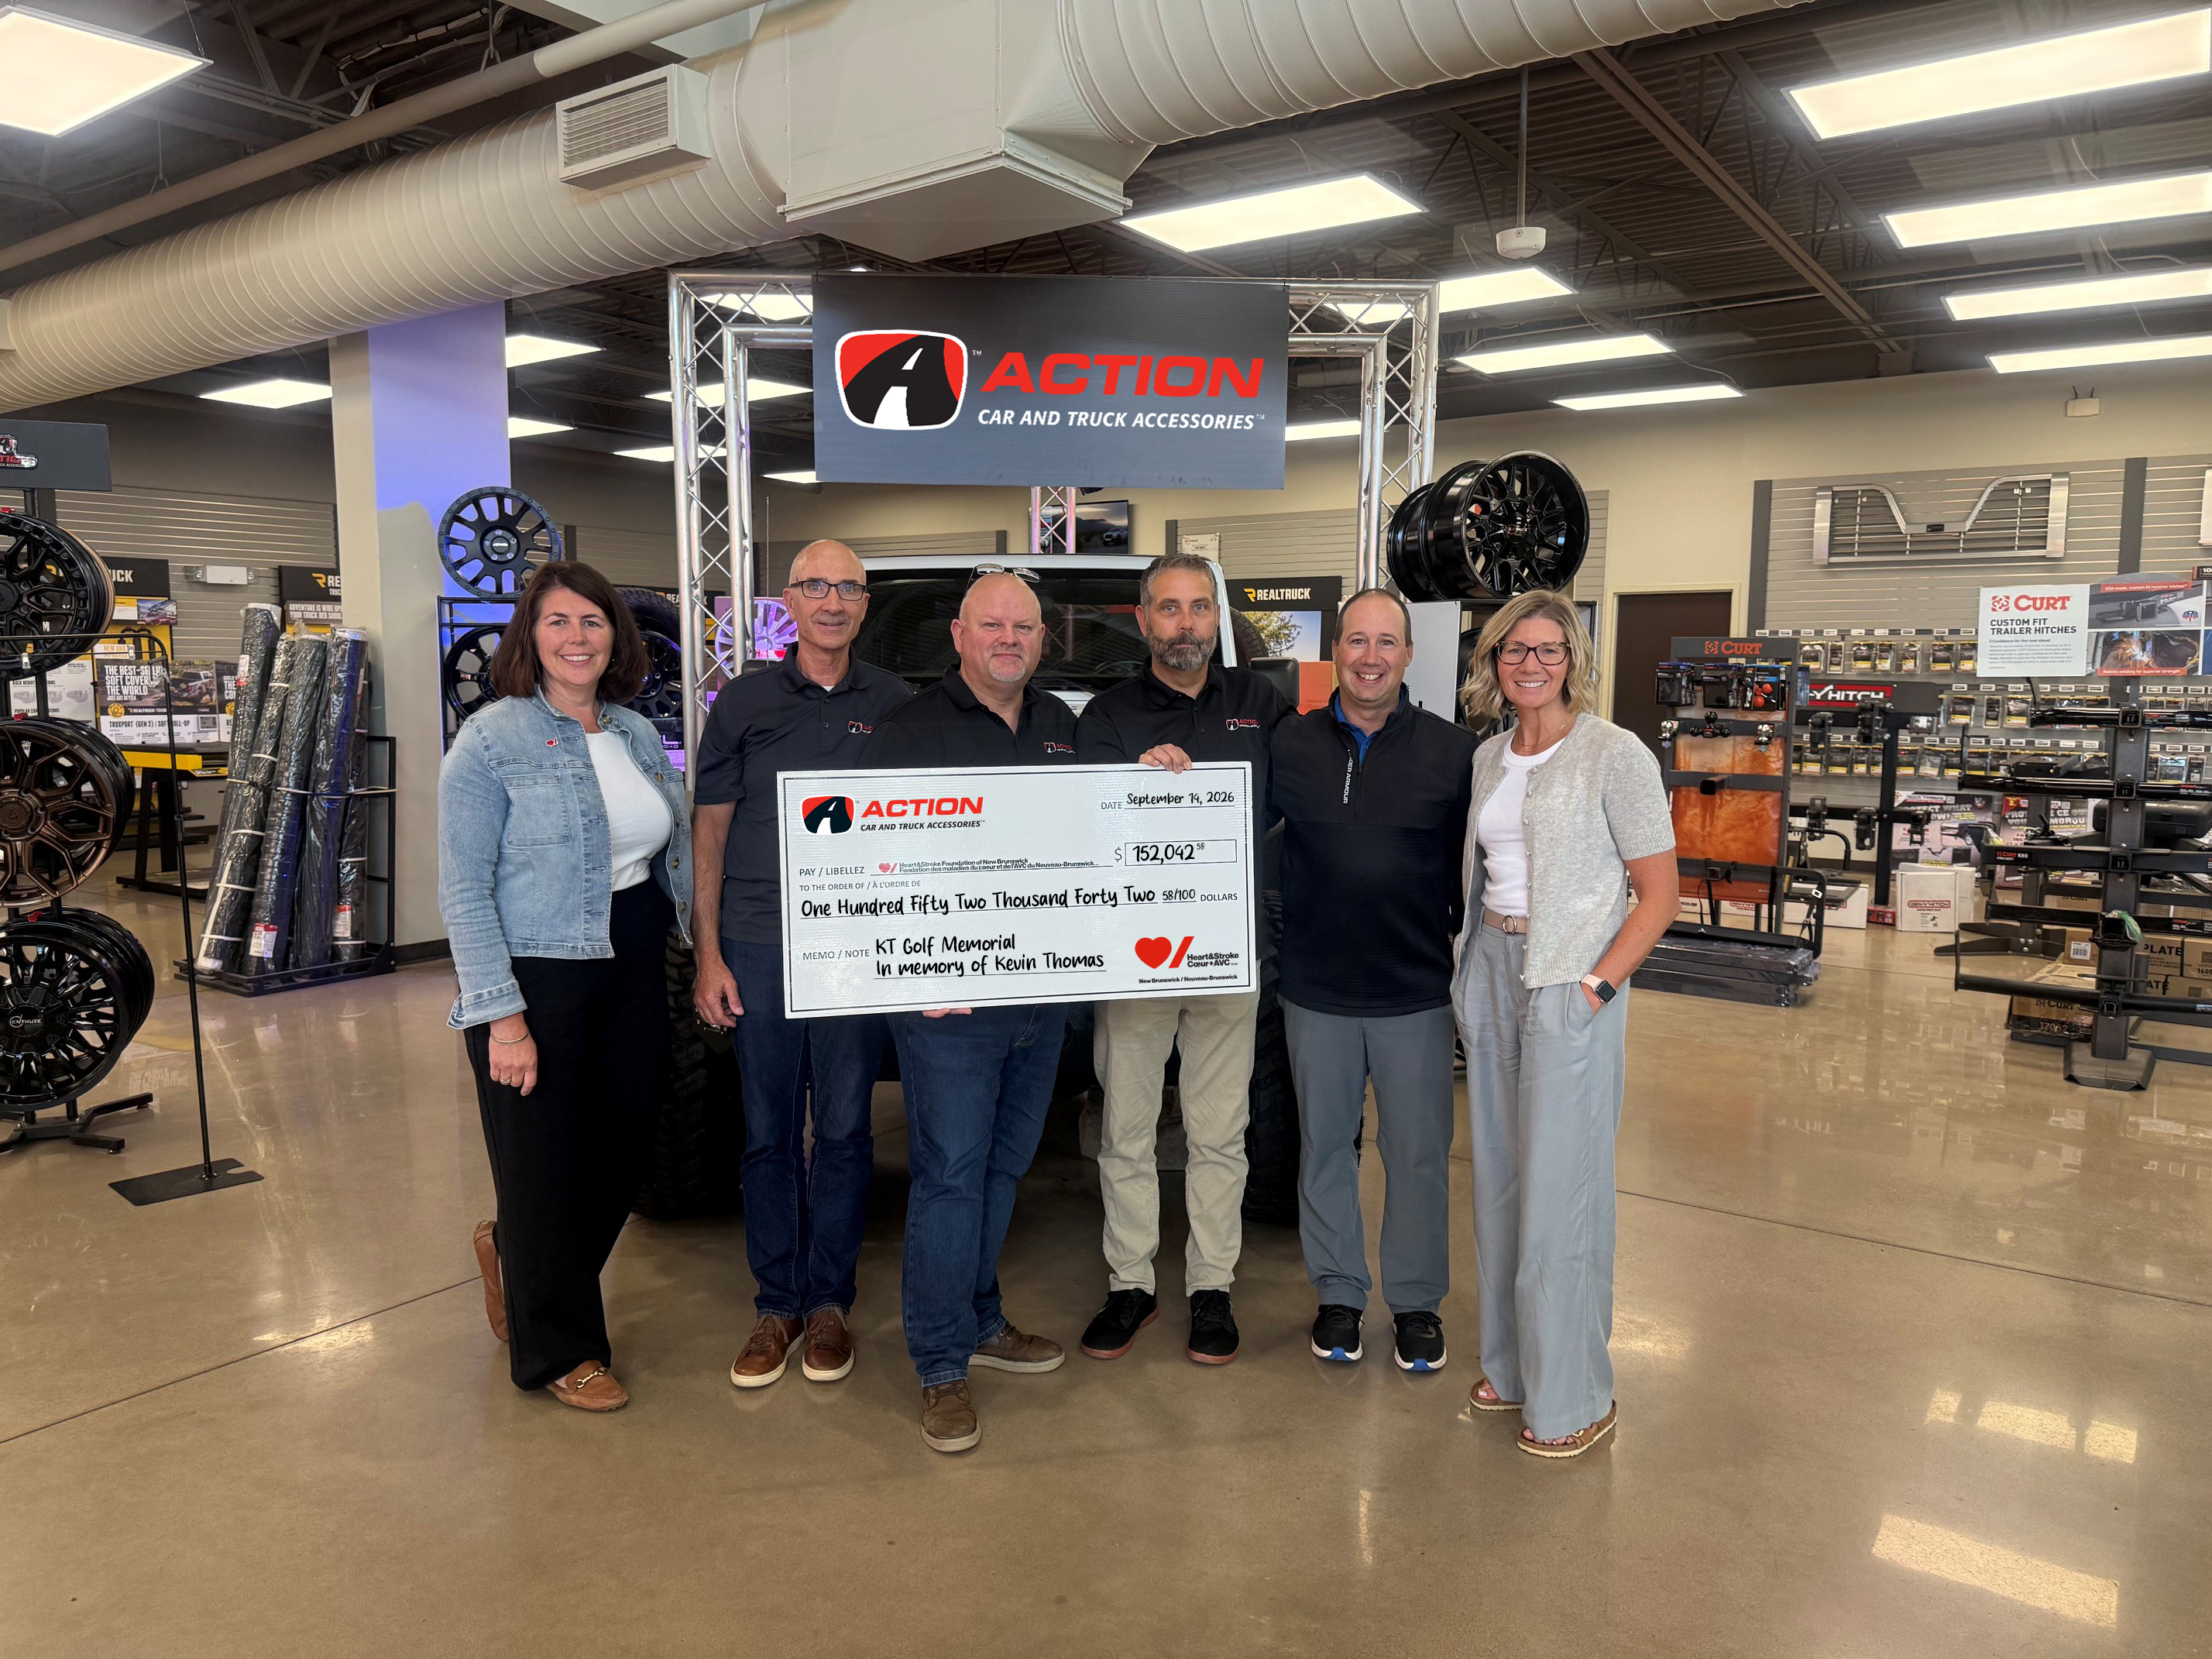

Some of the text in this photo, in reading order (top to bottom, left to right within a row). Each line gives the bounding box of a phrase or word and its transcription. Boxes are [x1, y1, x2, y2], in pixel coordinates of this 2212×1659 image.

[980, 352, 1265, 397] ACTION
[977, 409, 1016, 426] CAR
[1020, 410, 1060, 426] AND
[1068, 410, 1127, 428] TRUCK
[1132, 412, 1255, 430] ACCESSORIES
[1256, 588, 1311, 601] REALTRUCK
[2014, 594, 2070, 612] CURT
[1990, 618, 2030, 627] CUSTOM
[2034, 626, 2076, 634] HITCHES
[1721, 641, 1763, 655] CURT
[105, 665, 118, 675] THE
[105, 675, 125, 685] SOFT
[224, 681, 236, 690] THE
[106, 685, 148, 696] THE WORLD
[1828, 689, 1884, 701] HITCH
[172, 720, 191, 728] OLL-UP
[1342, 774, 1352, 805] ARMOUR
[1101, 792, 1235, 810] DATE September 14, 2026
[860, 797, 984, 818] ACTION
[878, 823, 896, 831] AND
[898, 822, 925, 830] TRUCK
[927, 820, 981, 830] ACCESSORIES
[1114, 847, 1122, 862] $
[1132, 843, 1196, 864] 152,042
[799, 867, 816, 877] PAY
[826, 866, 865, 876] LIBELLEZ
[872, 880, 878, 888] À
[880, 880, 909, 889] L'ORDRE
[801, 885, 1238, 917] One Hundred Fifty Two Thousand Forty Two 58/100 DOLLARS
[876, 933, 1015, 957] KT Golf Memorial
[802, 950, 835, 960] MEMO
[845, 949, 870, 958] NOTE
[1187, 952, 1239, 961] Heart&Stroke
[877, 952, 1104, 977] In memory of Kevin Thomas
